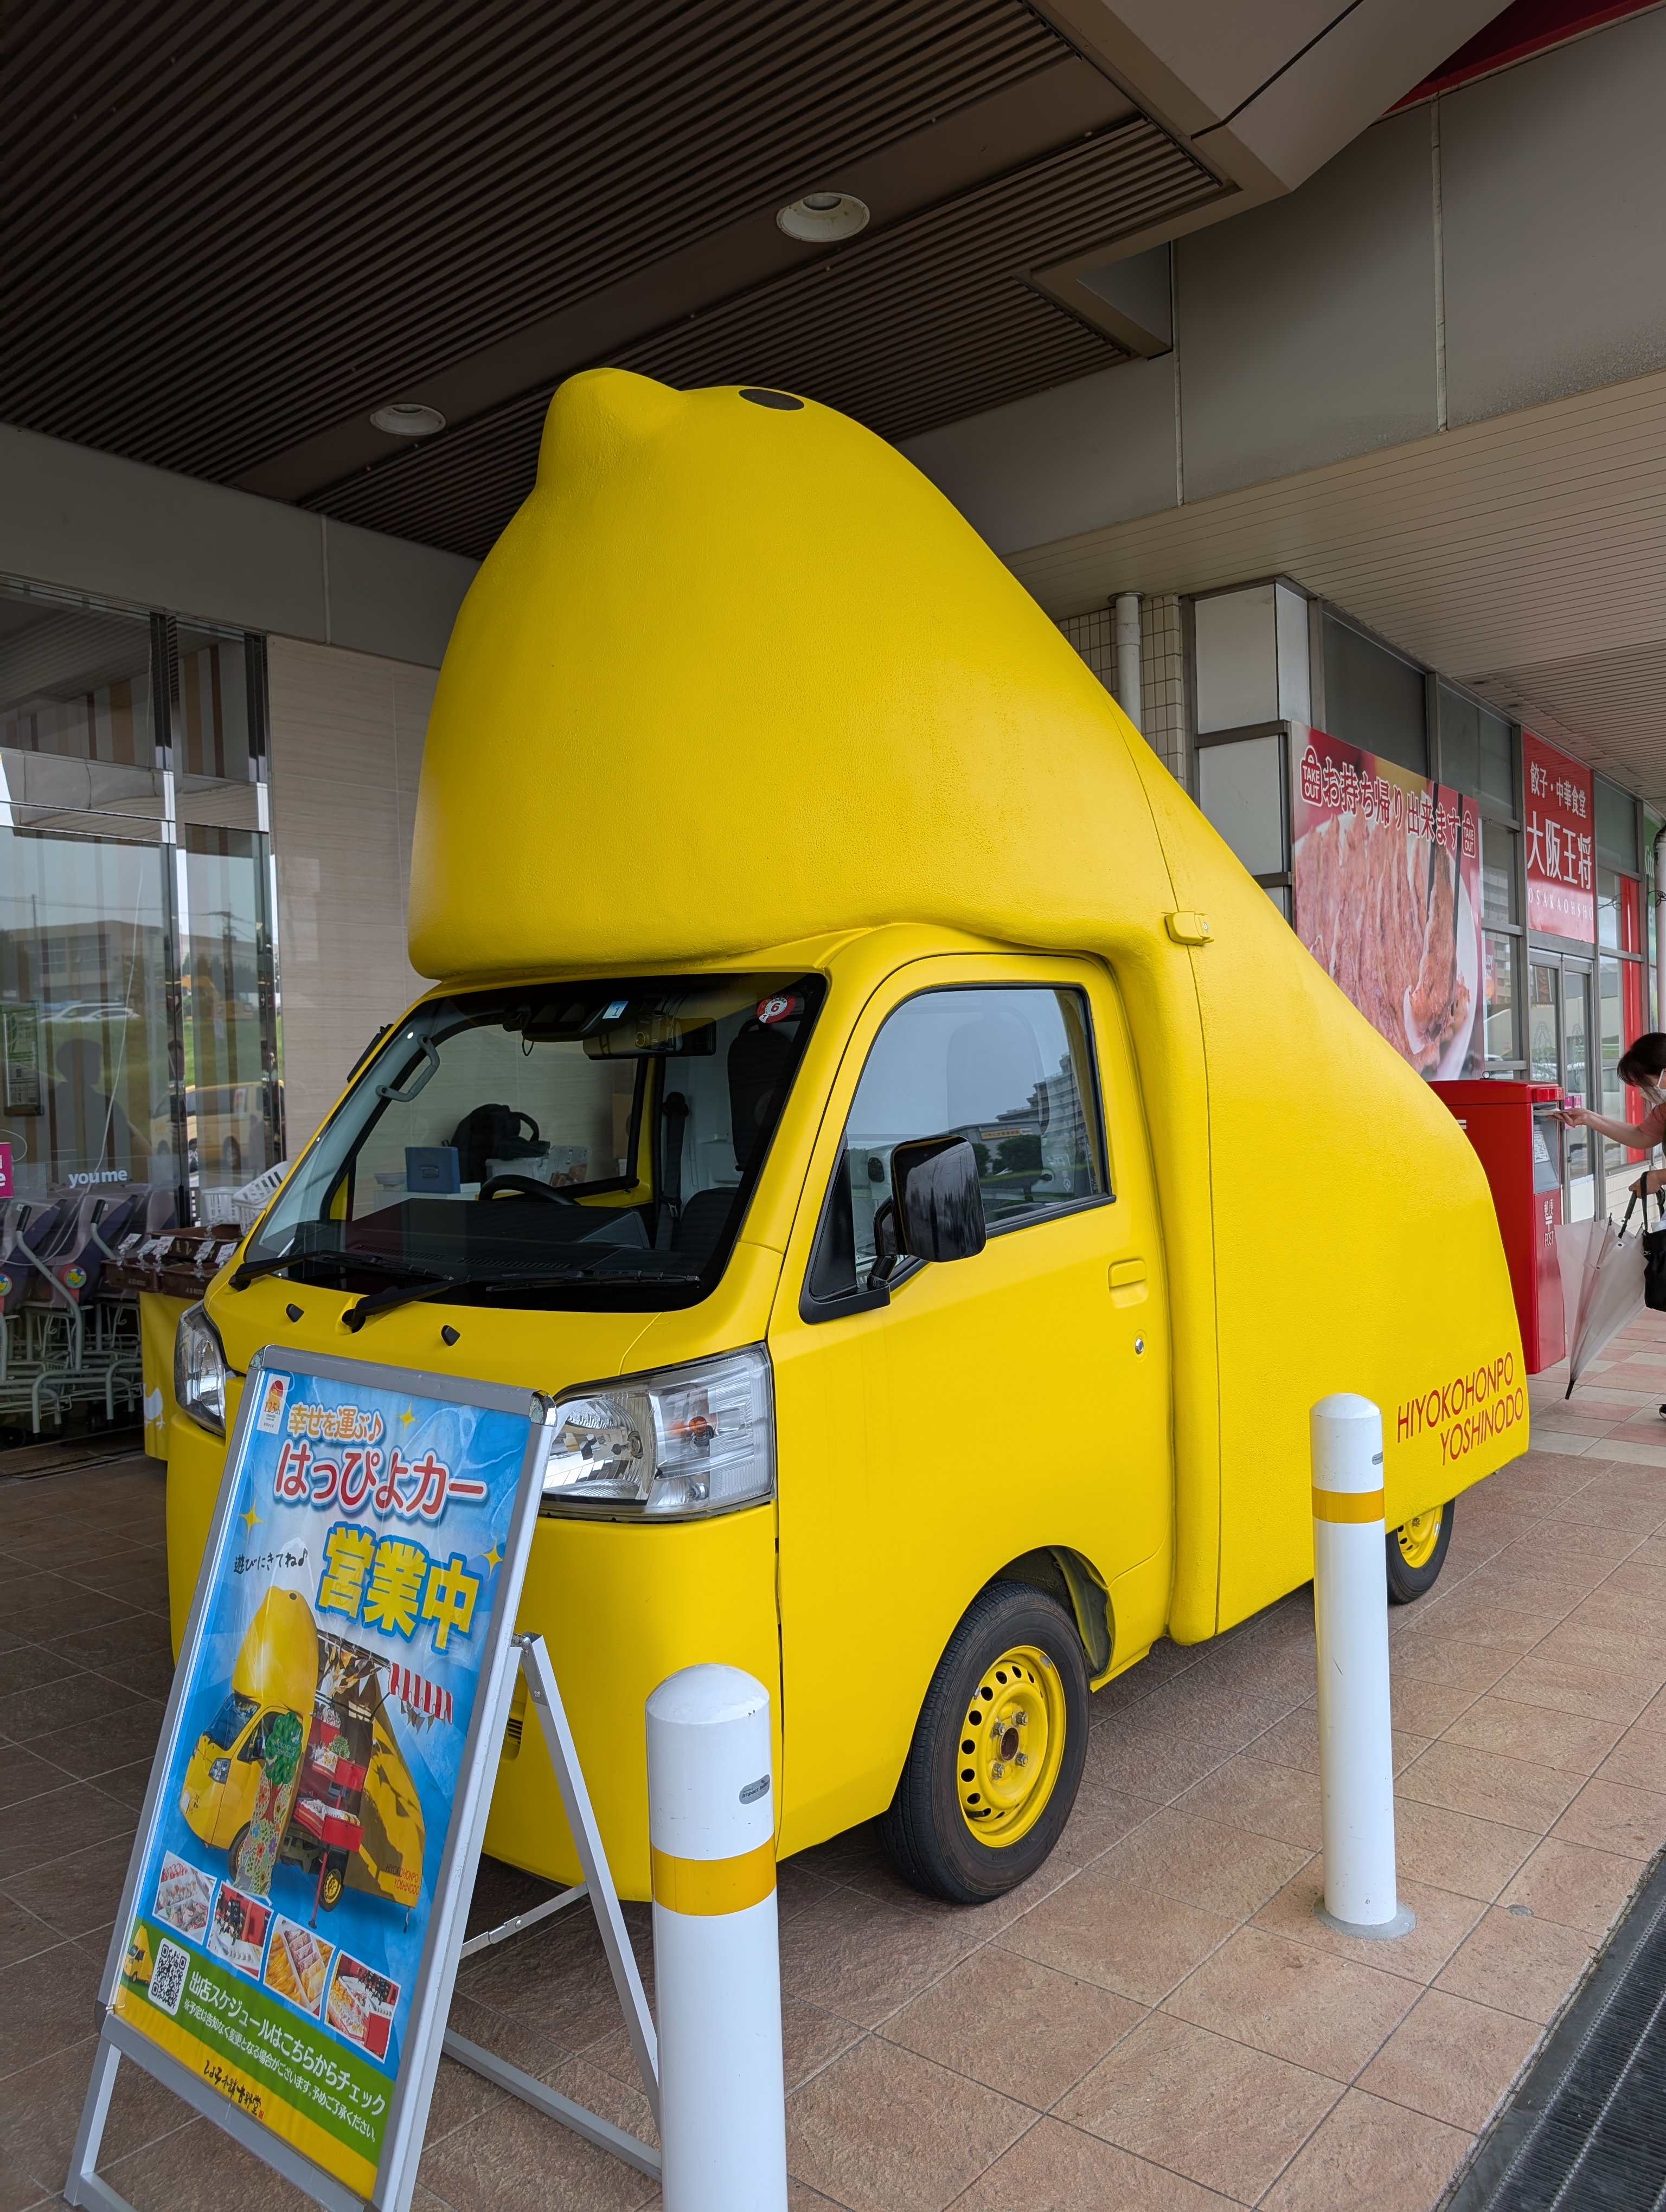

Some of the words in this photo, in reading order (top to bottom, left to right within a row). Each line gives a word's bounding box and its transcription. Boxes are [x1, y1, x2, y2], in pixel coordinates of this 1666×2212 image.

[1303, 766, 1320, 785] TAKE
[1304, 782, 1319, 799] OUT
[1530, 761, 1587, 819] 餃子・中華食堂
[1322, 756, 1460, 851] お持ち帰り出来ます
[1463, 826, 1474, 841] TAKE
[1464, 839, 1473, 853] OUT
[1527, 811, 1592, 890] 大阪王将
[1528, 888, 1594, 921] OSAKAOHSHO
[612, 1006, 620, 1017] 1
[771, 1003, 781, 1012] 6
[1545, 1231, 1554, 1247] POST
[264, 1401, 281, 1415] 125th
[1397, 1352, 1514, 1444] HIYOKOHONPO
[289, 1404, 371, 1439] 幸せを運ぶ
[1440, 1387, 1523, 1466] YOSHINODO
[318, 1527, 479, 1650] 営業中
[189, 1970, 386, 2115] 出店スケジュールはこちらからチェック
